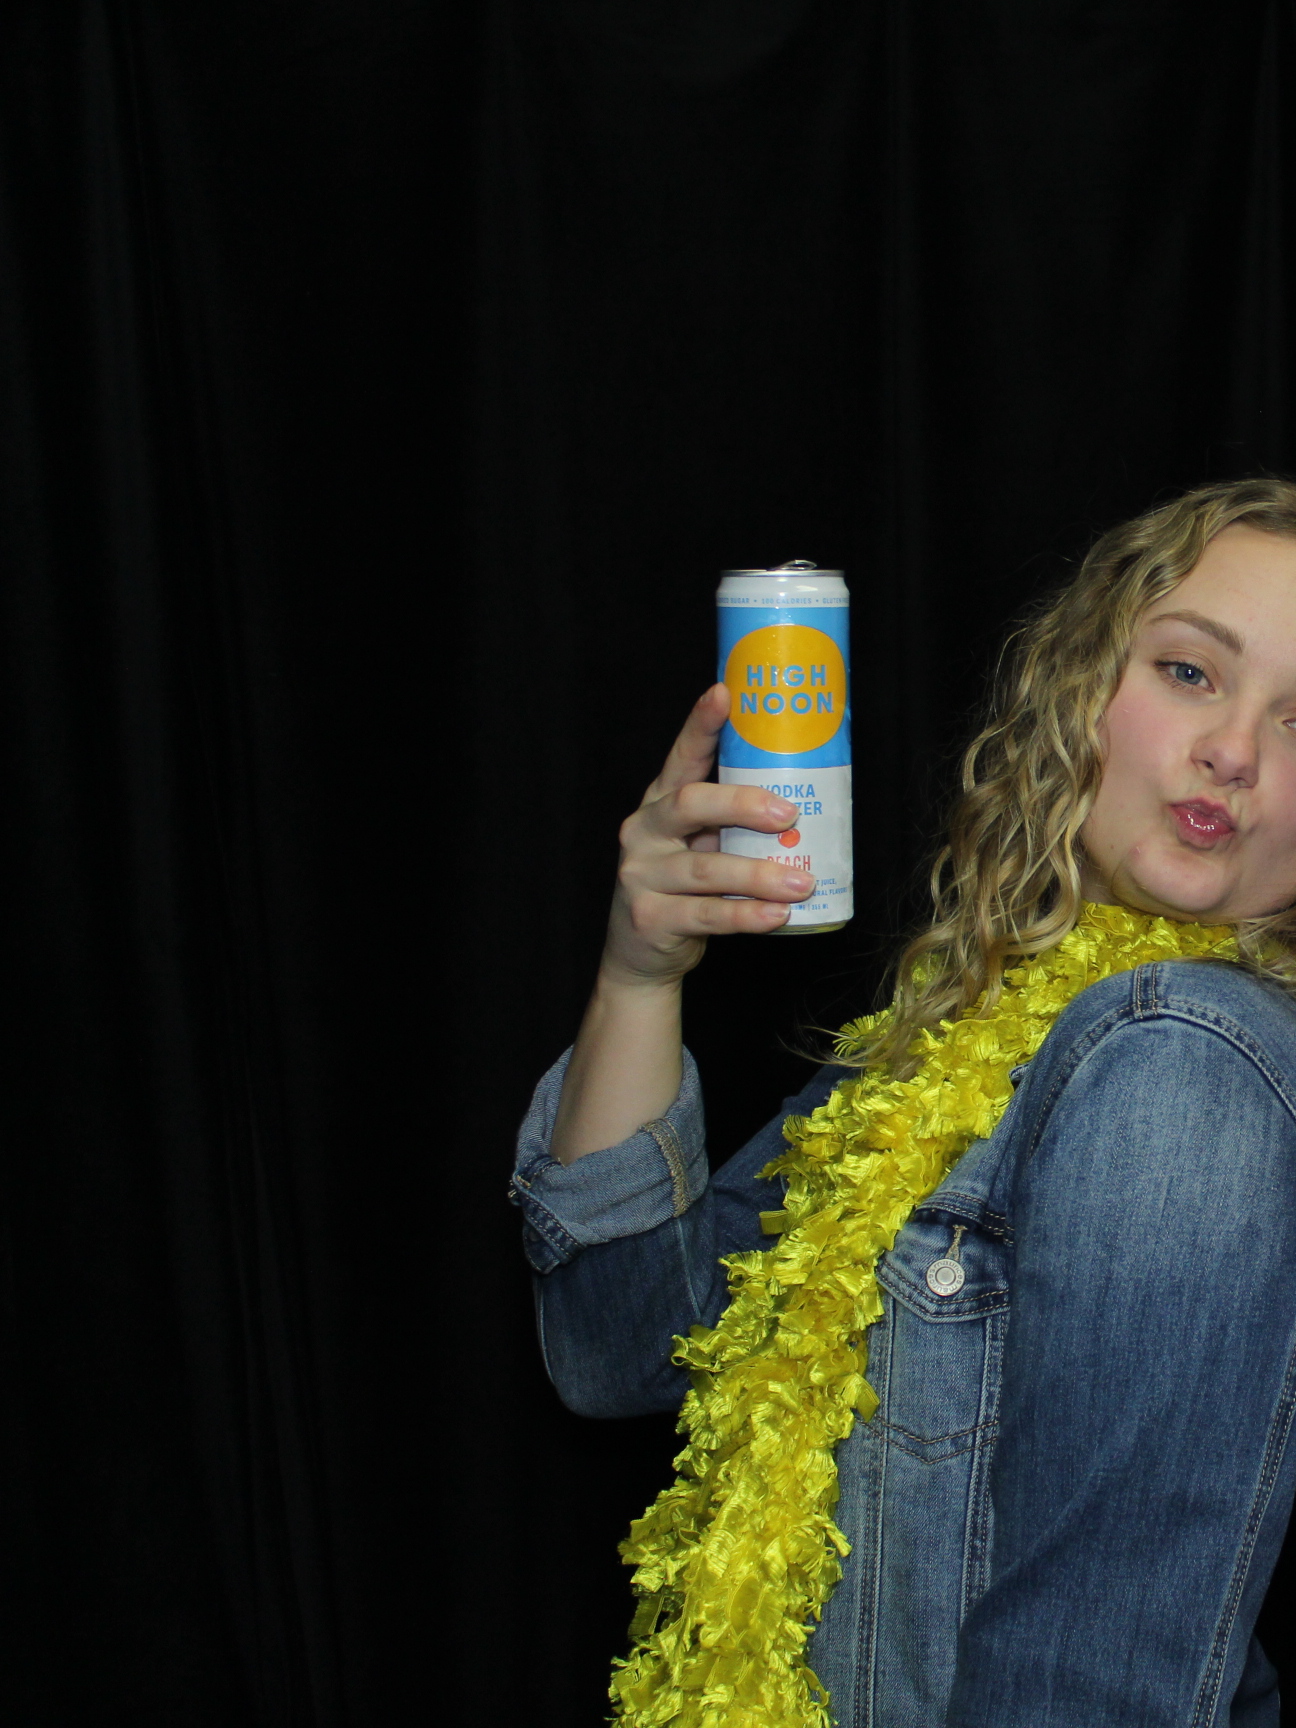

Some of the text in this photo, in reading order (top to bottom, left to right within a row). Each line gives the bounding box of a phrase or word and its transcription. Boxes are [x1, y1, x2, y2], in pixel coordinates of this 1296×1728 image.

[747, 665, 826, 687] HIGH
[740, 692, 834, 715] NOON
[767, 855, 811, 871] ACH
